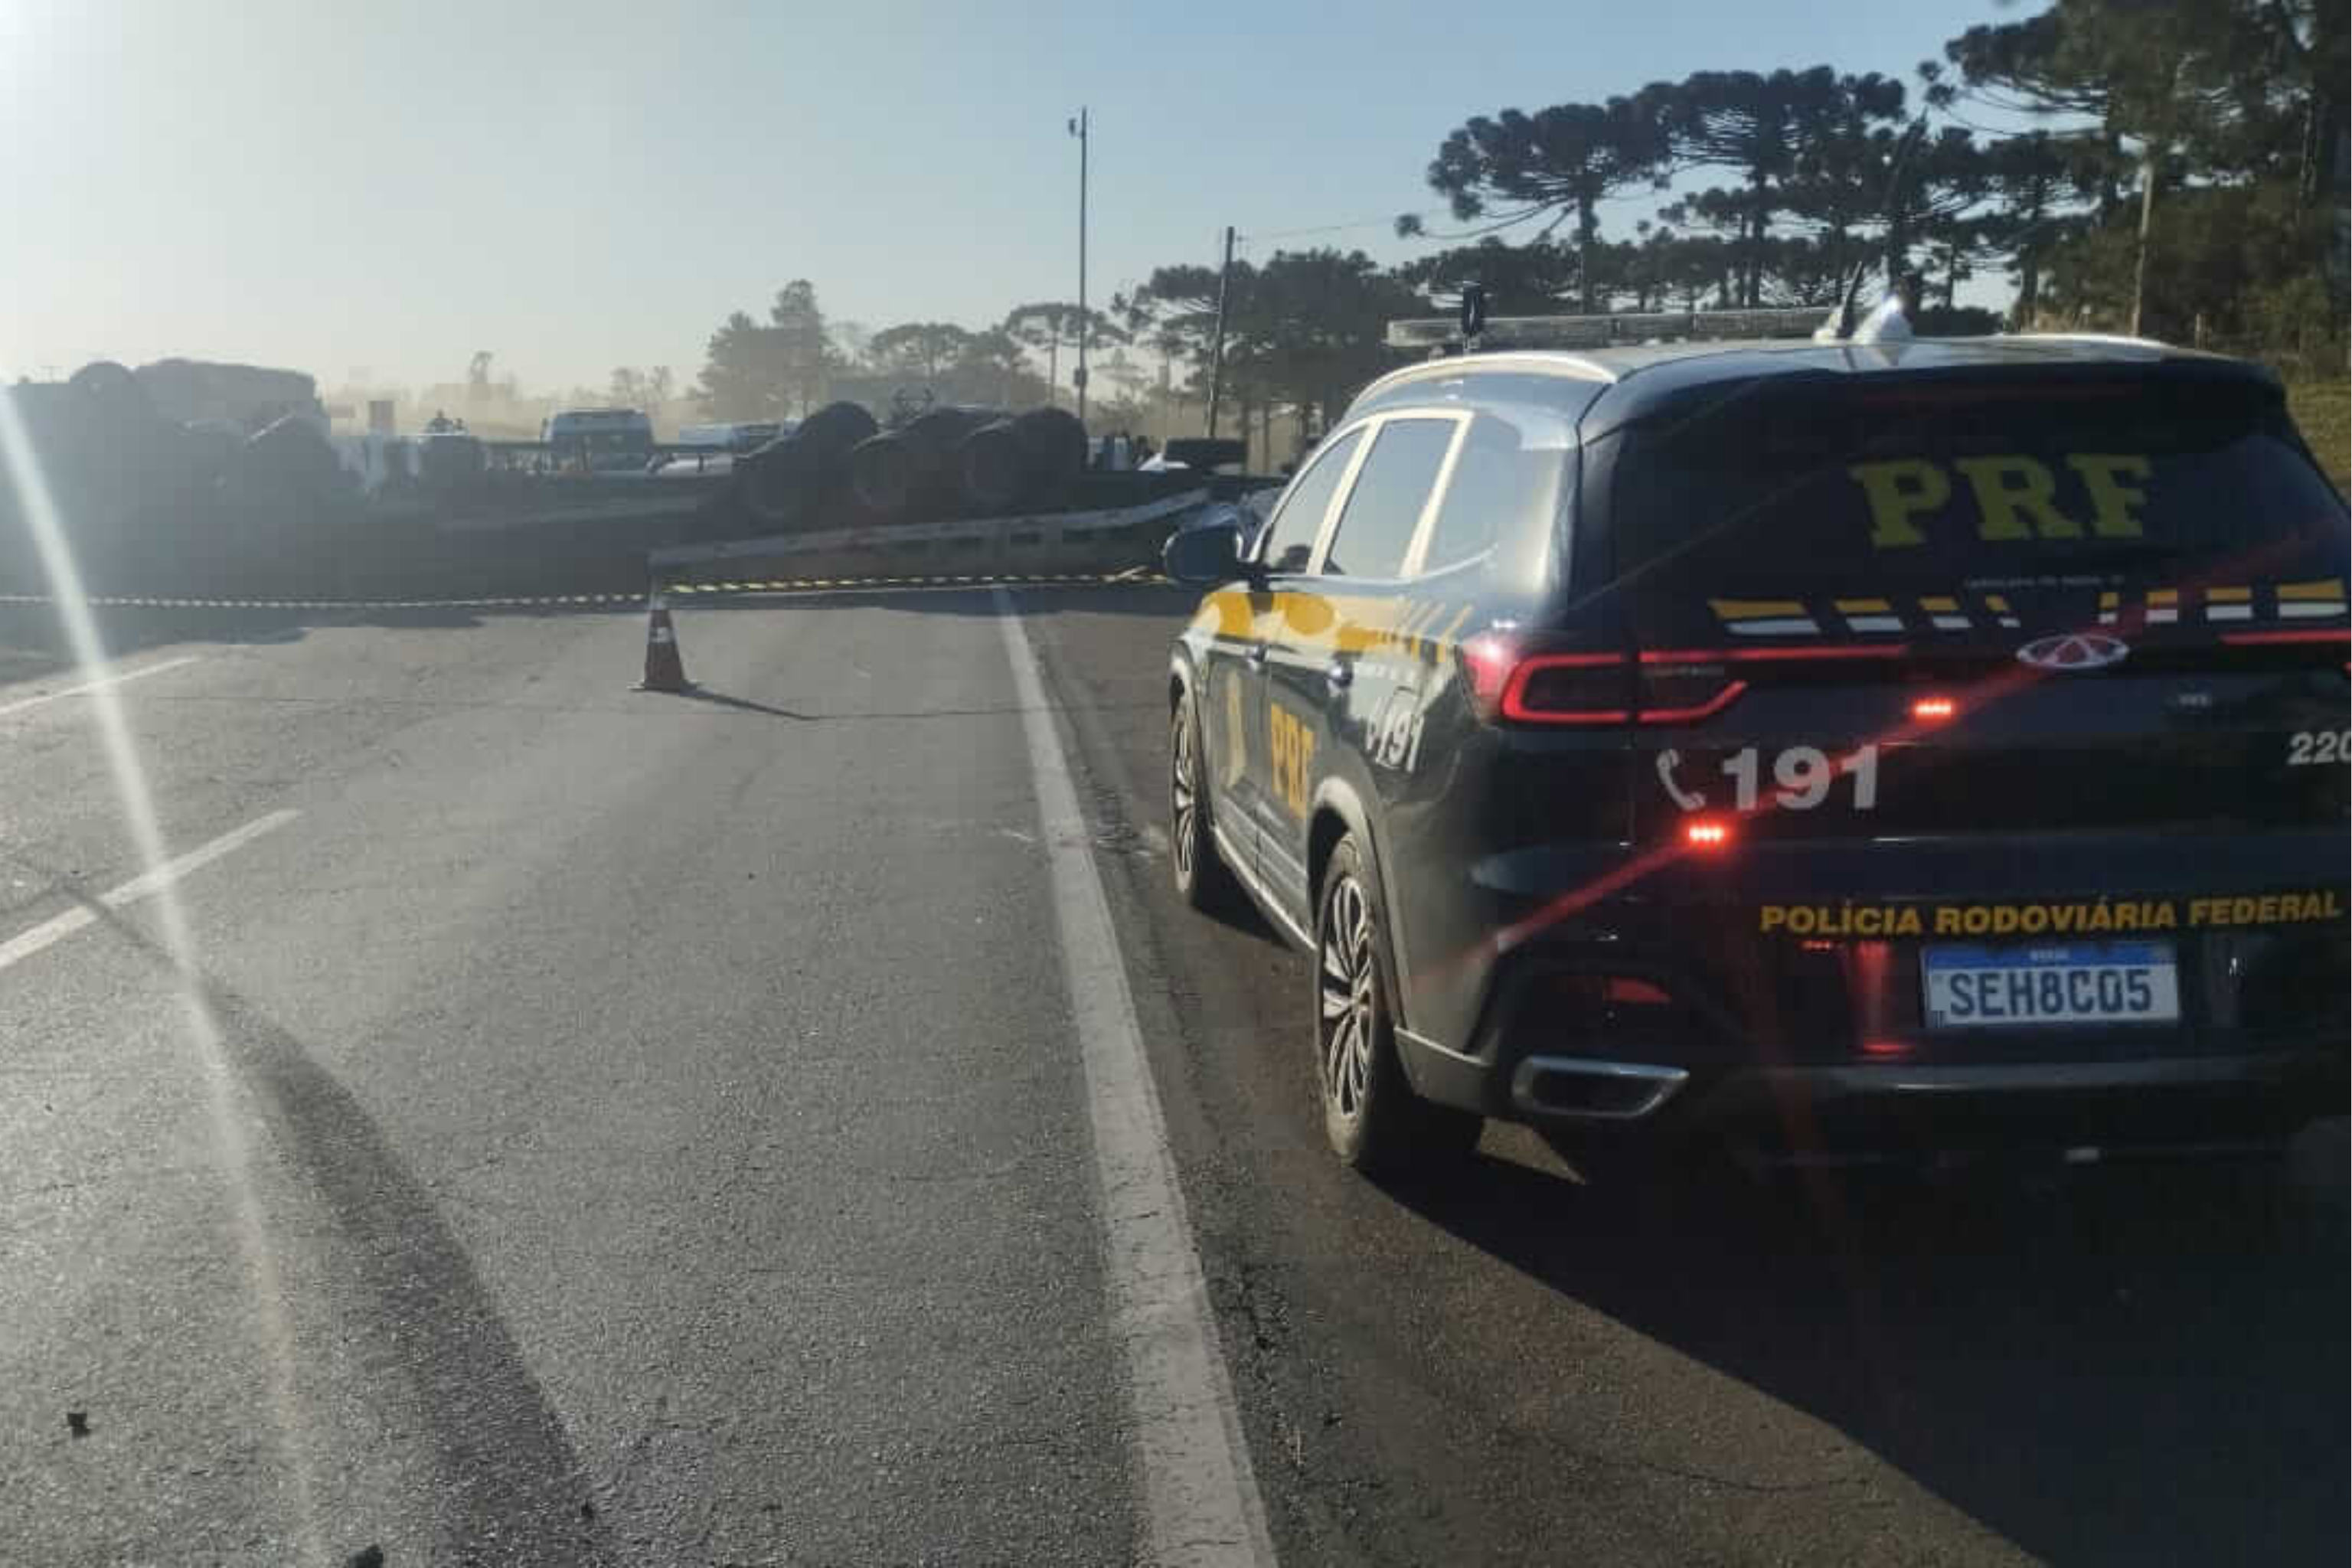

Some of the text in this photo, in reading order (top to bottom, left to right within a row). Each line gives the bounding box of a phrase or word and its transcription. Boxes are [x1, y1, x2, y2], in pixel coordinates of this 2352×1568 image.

[1848, 453, 2151, 548] PRF
[1722, 745, 1877, 811] 191
[1761, 890, 2342, 934] POLÍCIA RODOVIÁRIA FEDERAL
[1949, 968, 2152, 1016] SEH8C05
